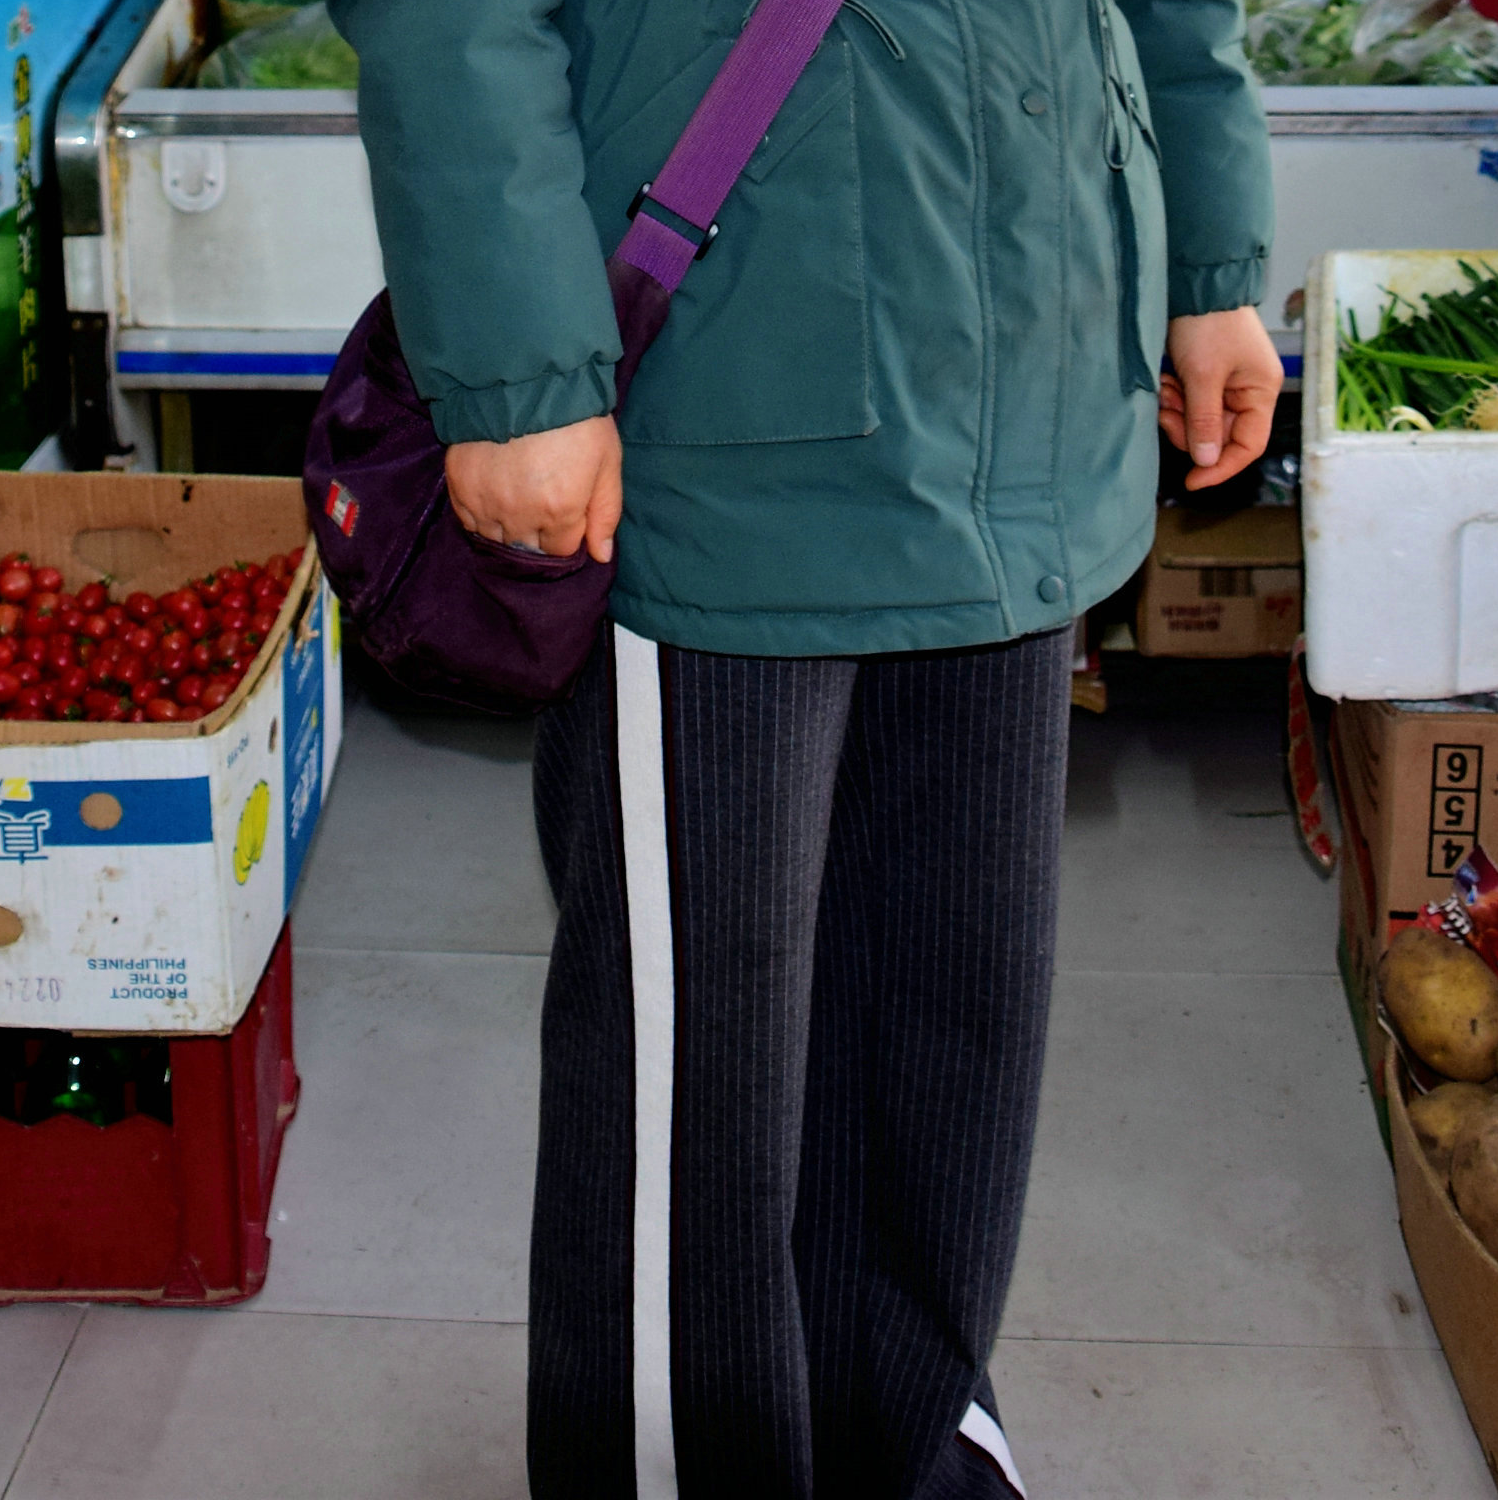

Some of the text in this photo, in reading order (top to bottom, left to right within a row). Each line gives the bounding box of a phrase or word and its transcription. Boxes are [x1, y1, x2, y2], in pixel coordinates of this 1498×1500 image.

[1446, 752, 1468, 783] 6
[1444, 795, 1466, 827] 5
[1442, 838, 1465, 869] 4
[87, 957, 186, 971] PHILIPPINES
[129, 973, 187, 985] OF THE
[110, 987, 188, 1000] PRODUCT
